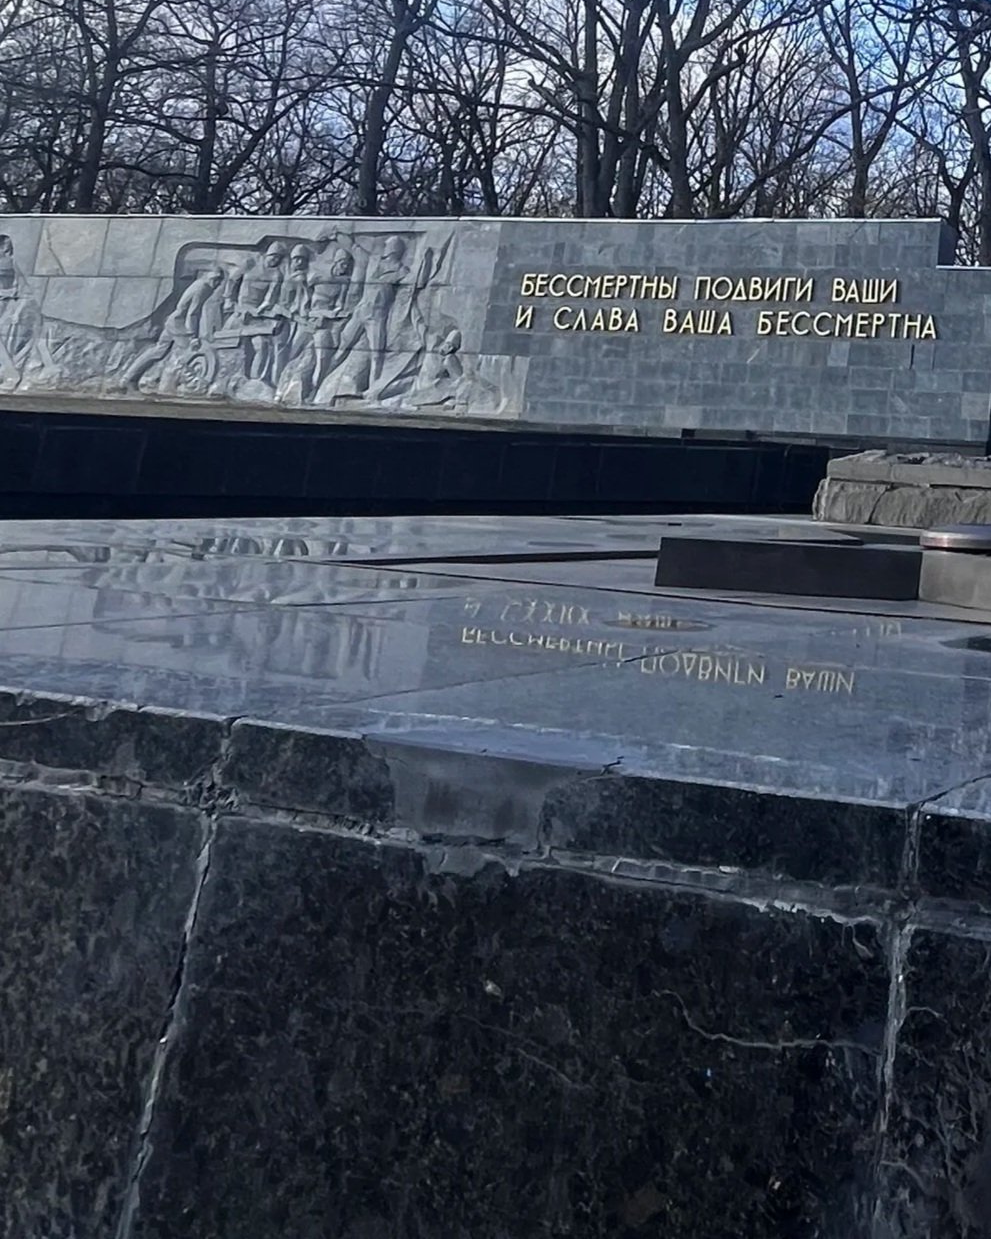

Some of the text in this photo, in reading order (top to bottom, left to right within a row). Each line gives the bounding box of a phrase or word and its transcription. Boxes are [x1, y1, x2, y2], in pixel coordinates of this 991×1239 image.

[521, 273, 898, 303] БЕССМЕРТНЫ ПОДВИГИ ВАШИ
[515, 305, 937, 339] И СЛАВА ВАША БЕССМЕРТНА
